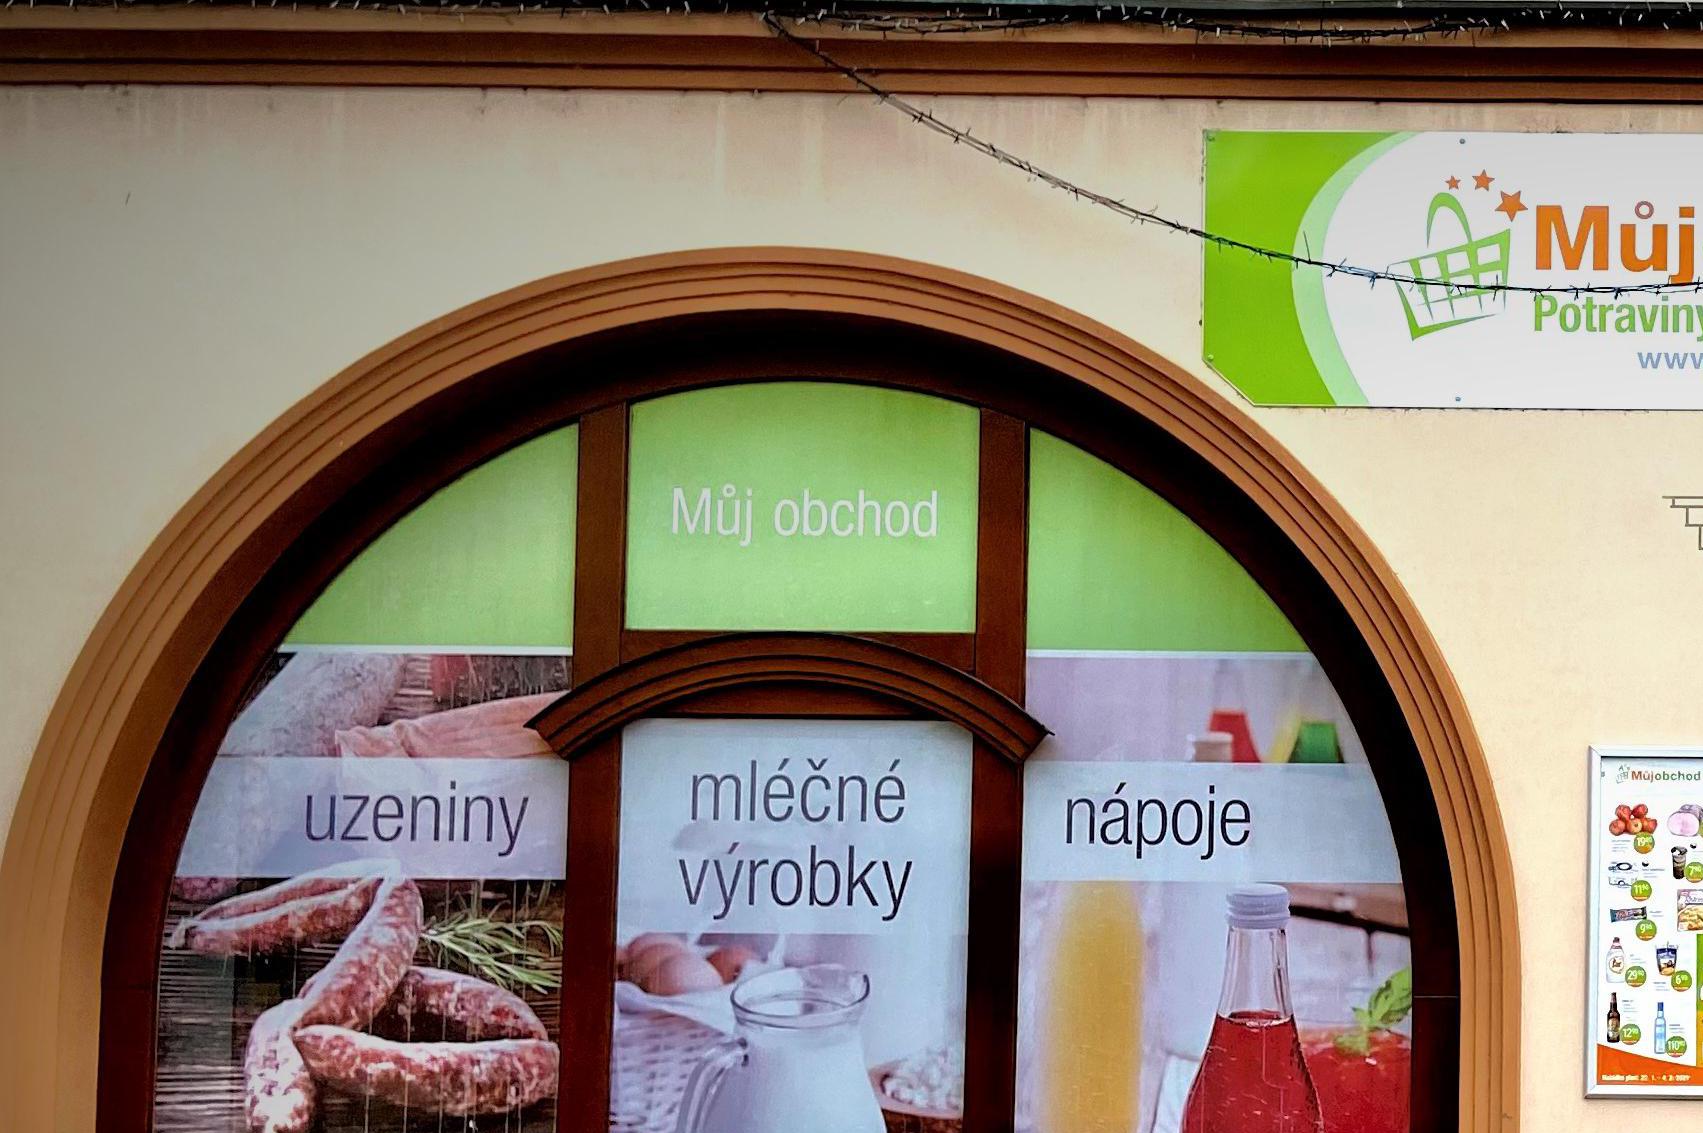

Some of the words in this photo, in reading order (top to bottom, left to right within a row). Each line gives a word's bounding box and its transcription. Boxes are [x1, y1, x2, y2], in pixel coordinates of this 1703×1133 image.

[671, 484, 753, 547] Můj
[773, 488, 938, 538] obchod
[305, 780, 529, 857] uzeniny
[690, 758, 906, 823] mléčné
[1065, 782, 1251, 861] nápoje
[678, 842, 913, 921] výrobky
